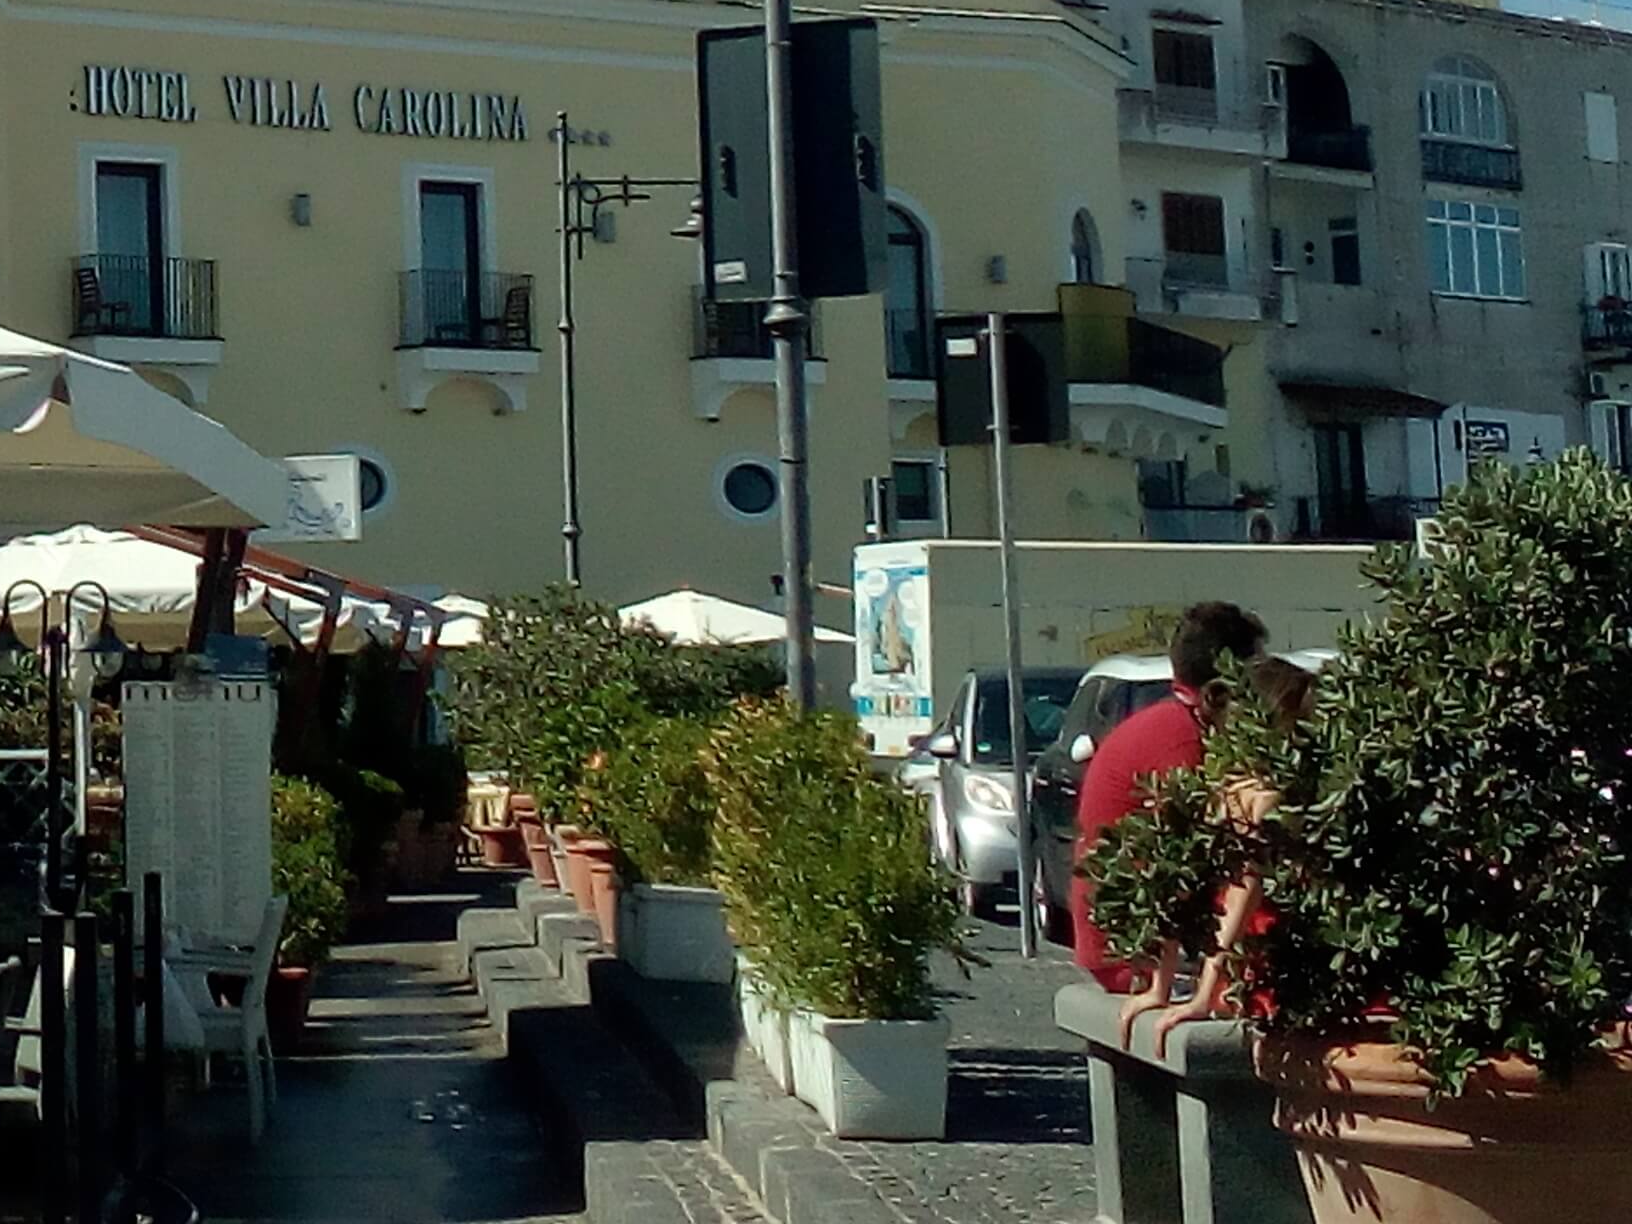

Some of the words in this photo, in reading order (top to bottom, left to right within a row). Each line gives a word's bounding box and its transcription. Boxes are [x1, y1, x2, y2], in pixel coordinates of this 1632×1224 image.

[83, 65, 198, 122] HOTEL
[224, 75, 330, 131] VILLA
[354, 85, 528, 141] CAROLINA
